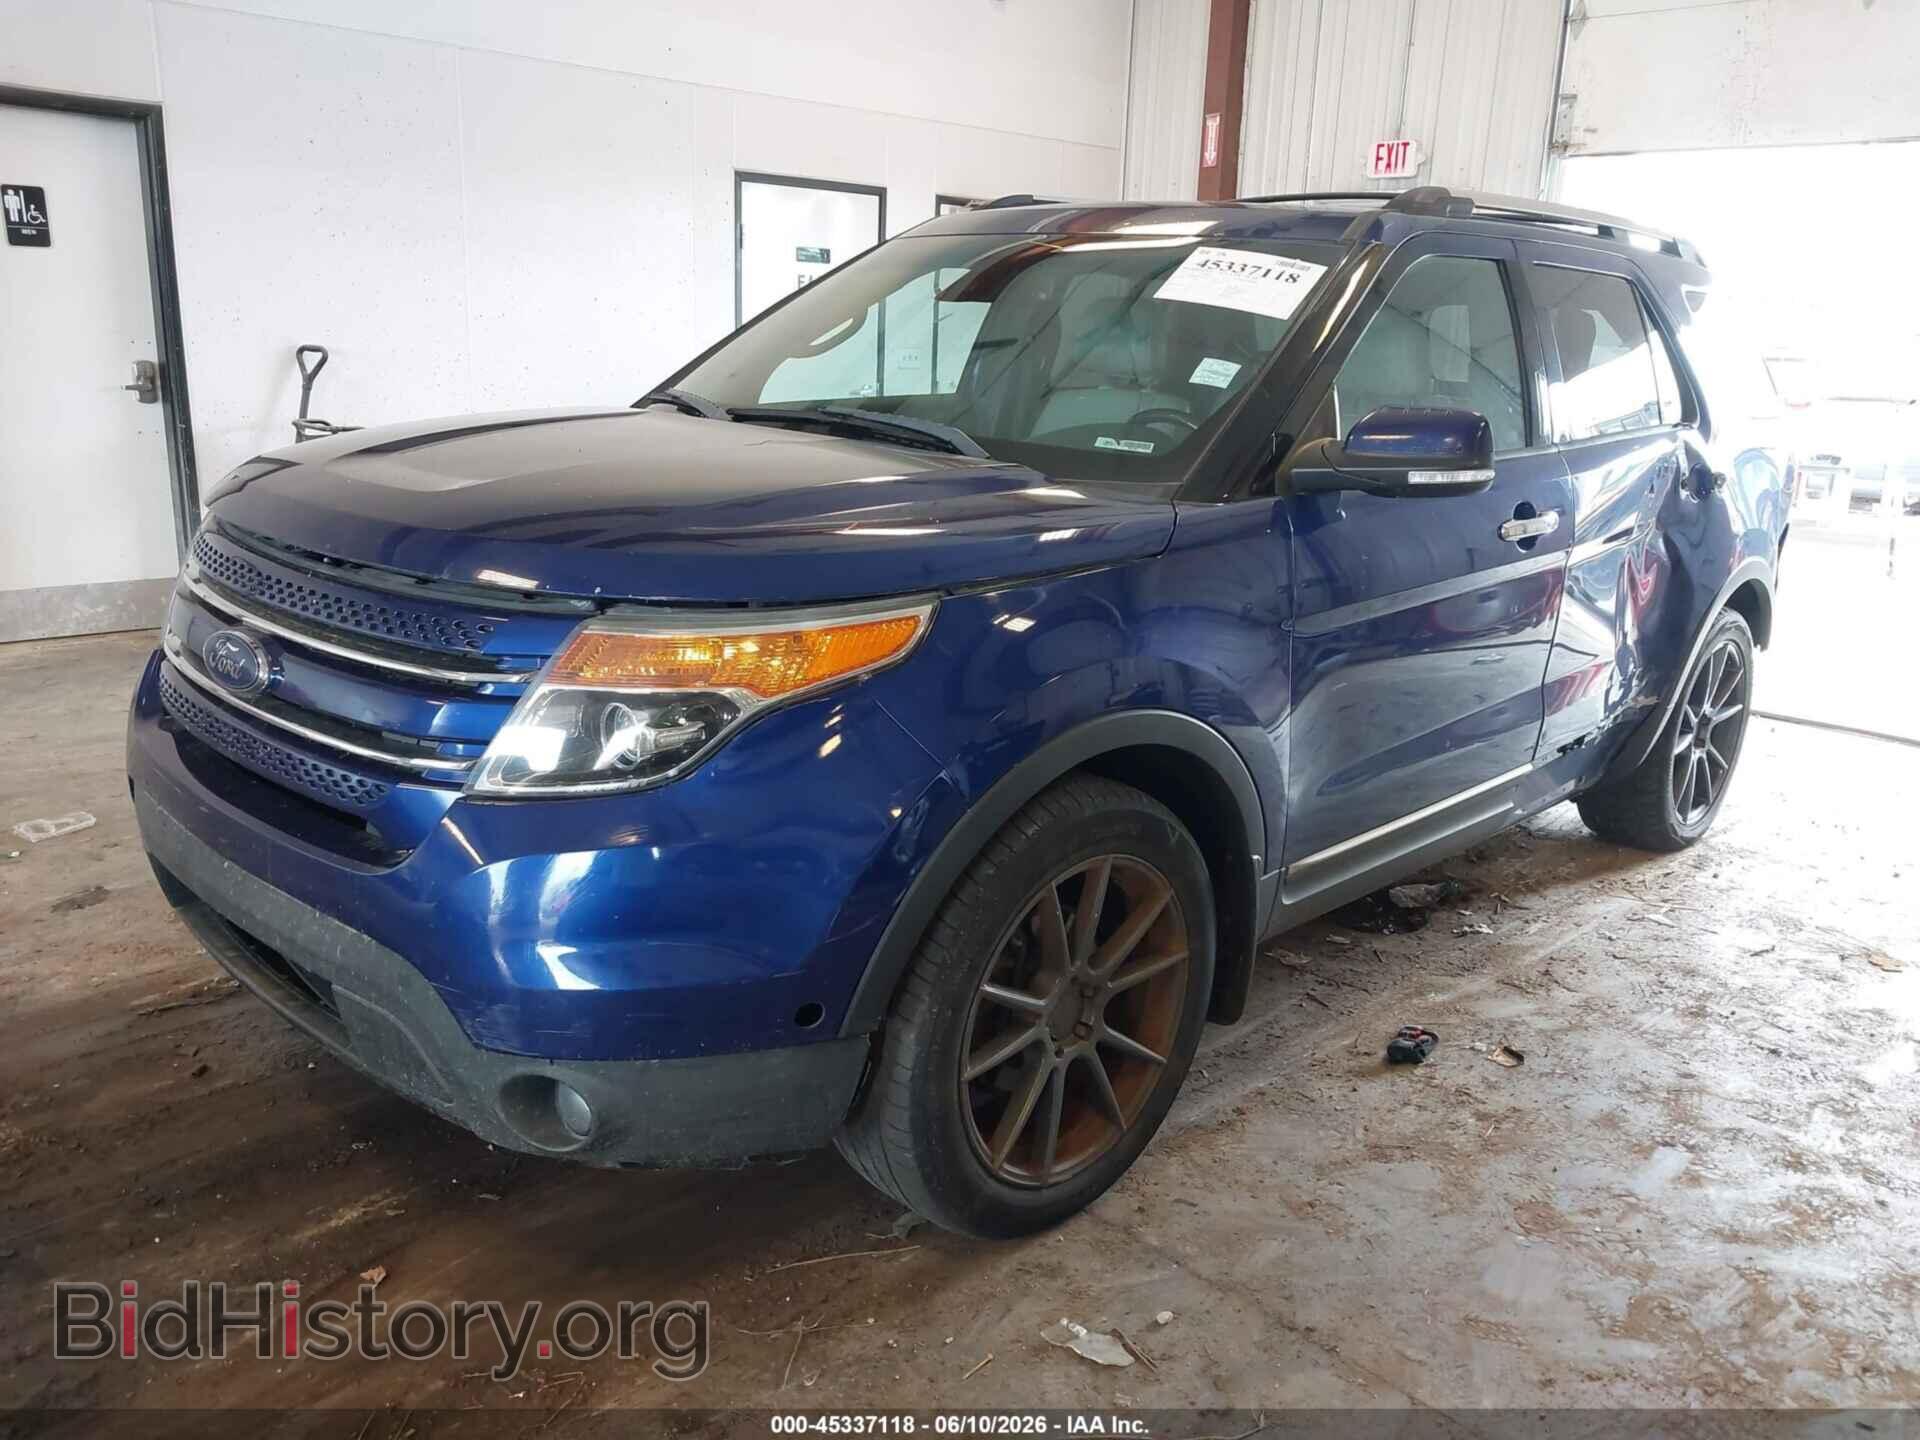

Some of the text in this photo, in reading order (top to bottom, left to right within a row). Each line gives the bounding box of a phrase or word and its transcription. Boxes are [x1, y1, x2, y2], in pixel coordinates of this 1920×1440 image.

[1374, 142, 1410, 174] EXIT
[1197, 259, 1301, 284] 45337118
[208, 639, 247, 679] Ford
